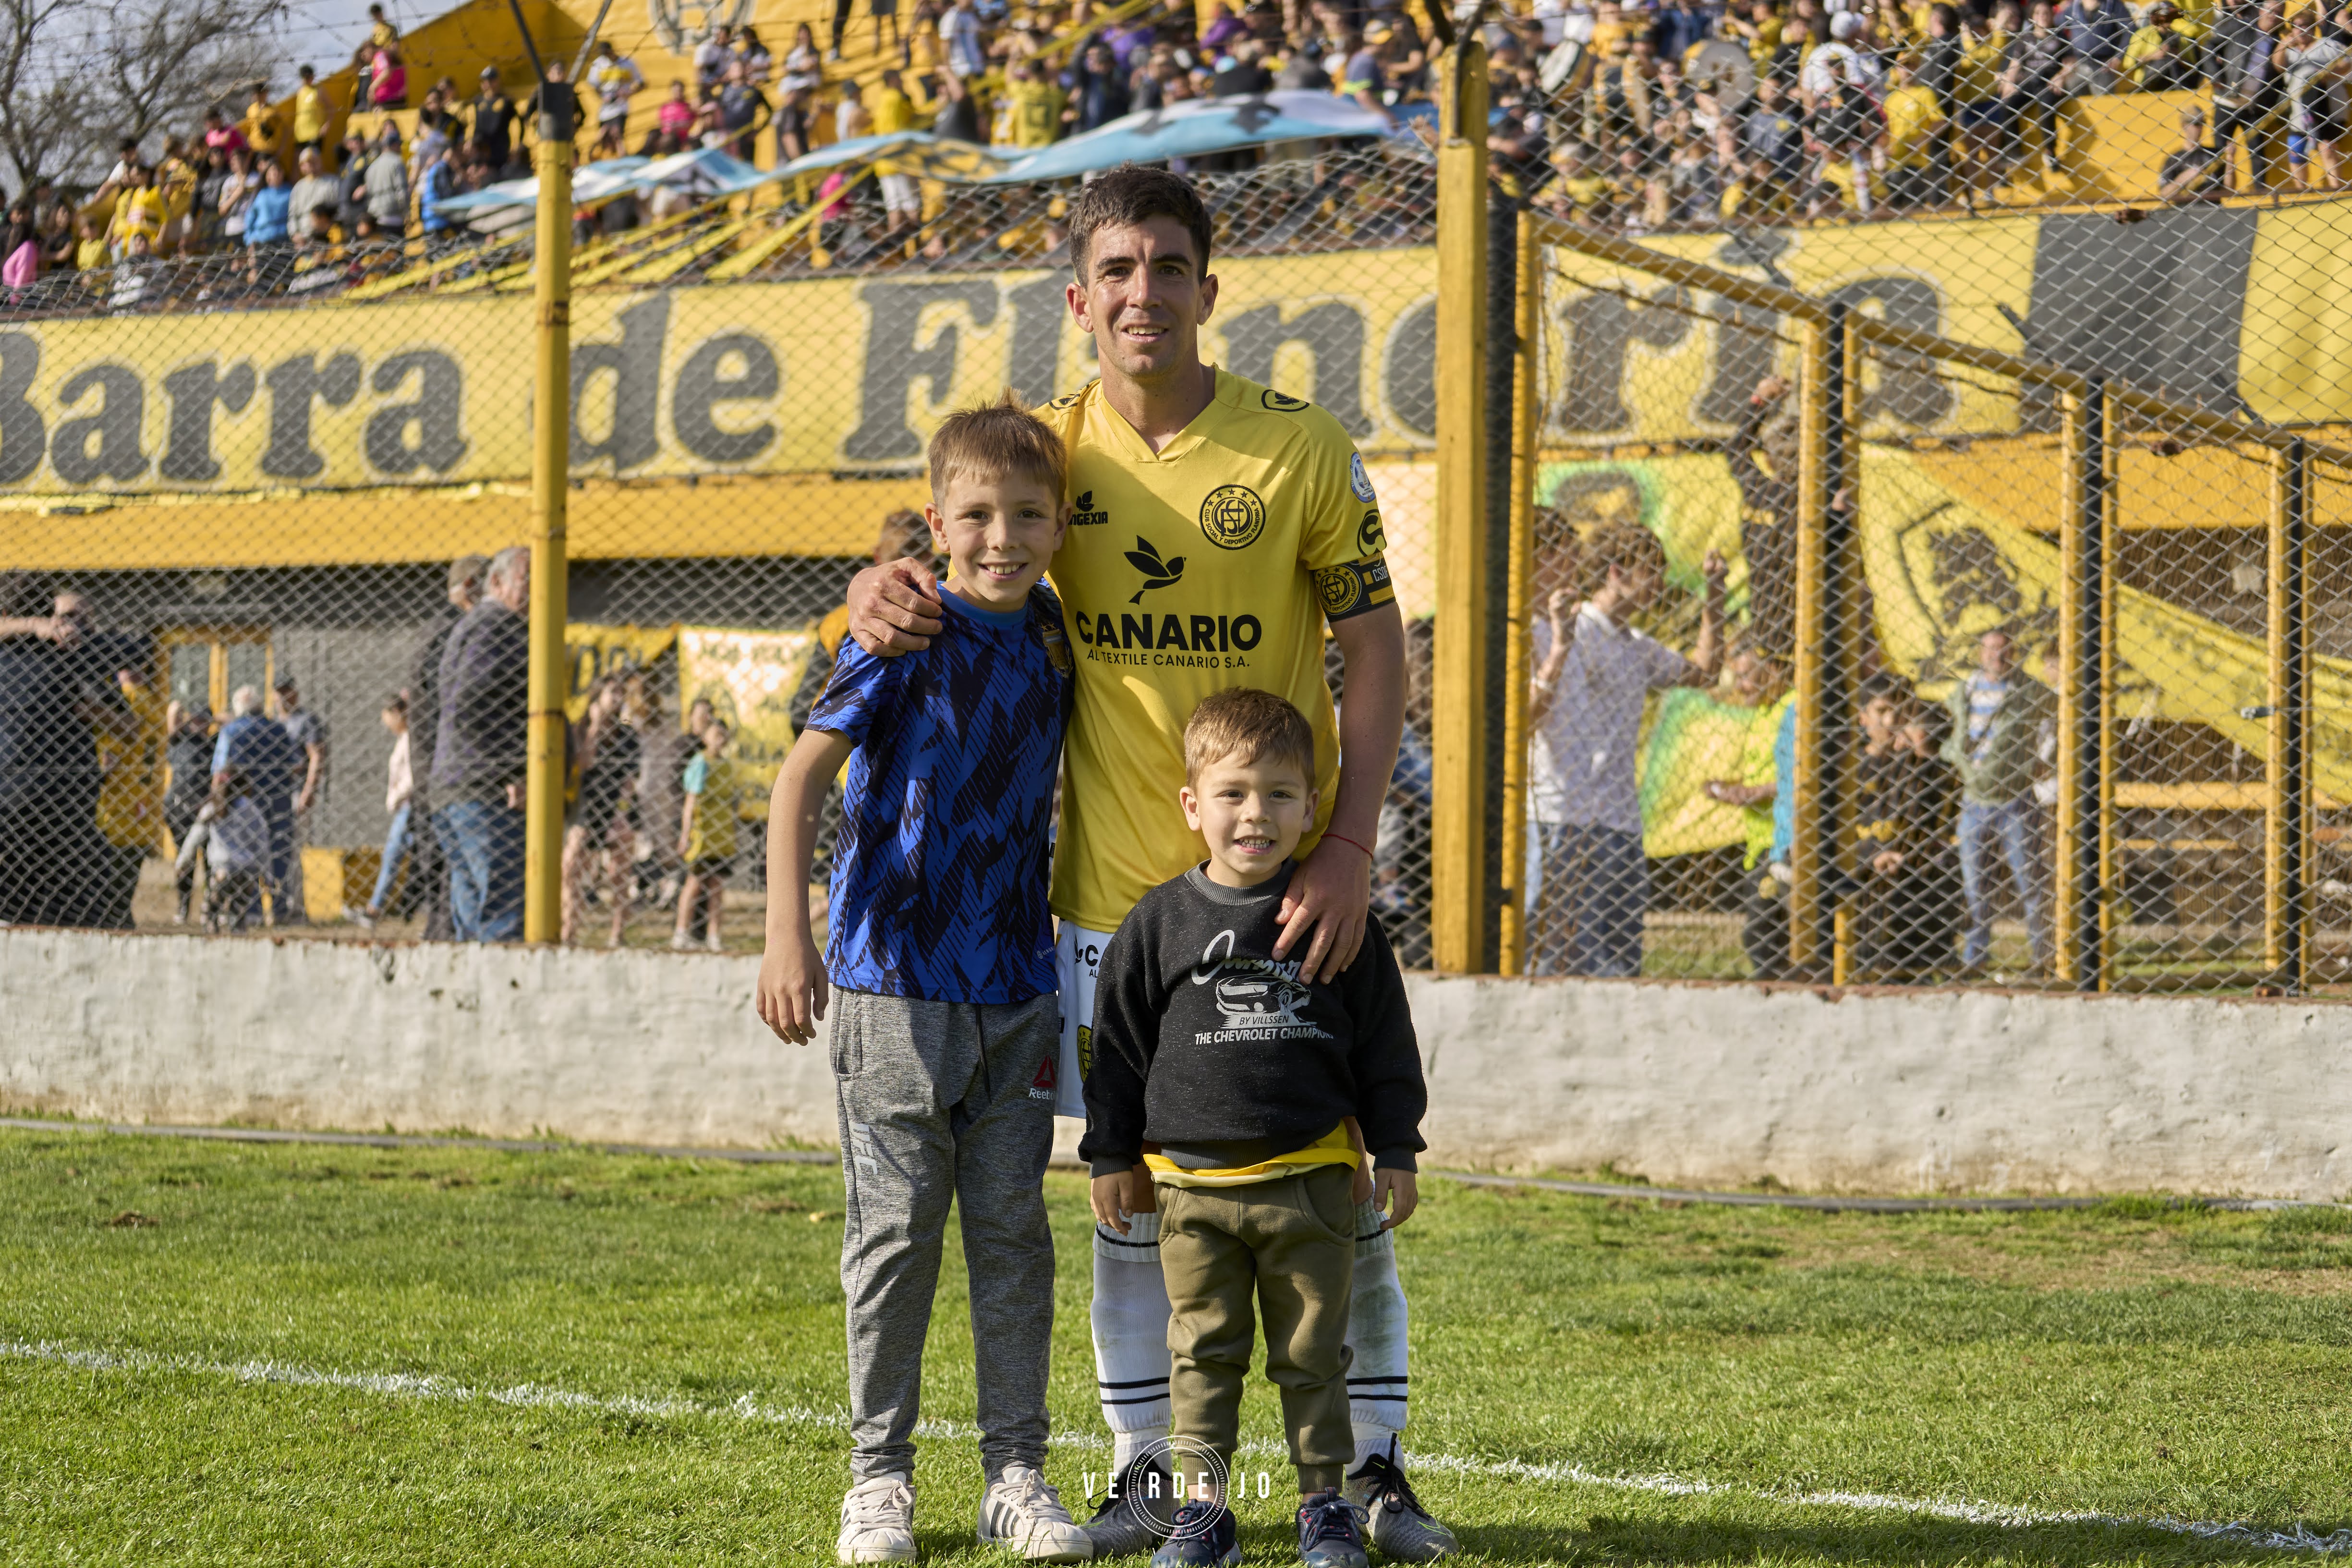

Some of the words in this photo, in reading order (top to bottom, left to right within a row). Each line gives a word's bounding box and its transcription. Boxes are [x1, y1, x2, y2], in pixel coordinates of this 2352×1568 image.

[570, 292, 780, 470] de
[1068, 511, 1108, 525] NGEXIA
[1206, 523, 1218, 539] SOCIAL
[1224, 533, 1252, 545] DEPORTIVO
[1251, 508, 1261, 534] FLANDRIA
[1332, 597, 1353, 611] DEPORTIVO
[1076, 611, 1262, 652] CANARIO
[1087, 649, 1100, 661] AL
[1102, 652, 1148, 666] TEXTILE
[1153, 654, 1219, 669] CANARIO
[1224, 656, 1250, 669] S.A.
[1239, 1017, 1251, 1025] BY
[1252, 1015, 1289, 1025] VILLSSEN
[1195, 1032, 1212, 1045] THE
[1214, 1028, 1278, 1043] CHEVROLET
[1029, 1088, 1055, 1101] Reebo
[849, 1119, 878, 1175] UFC
